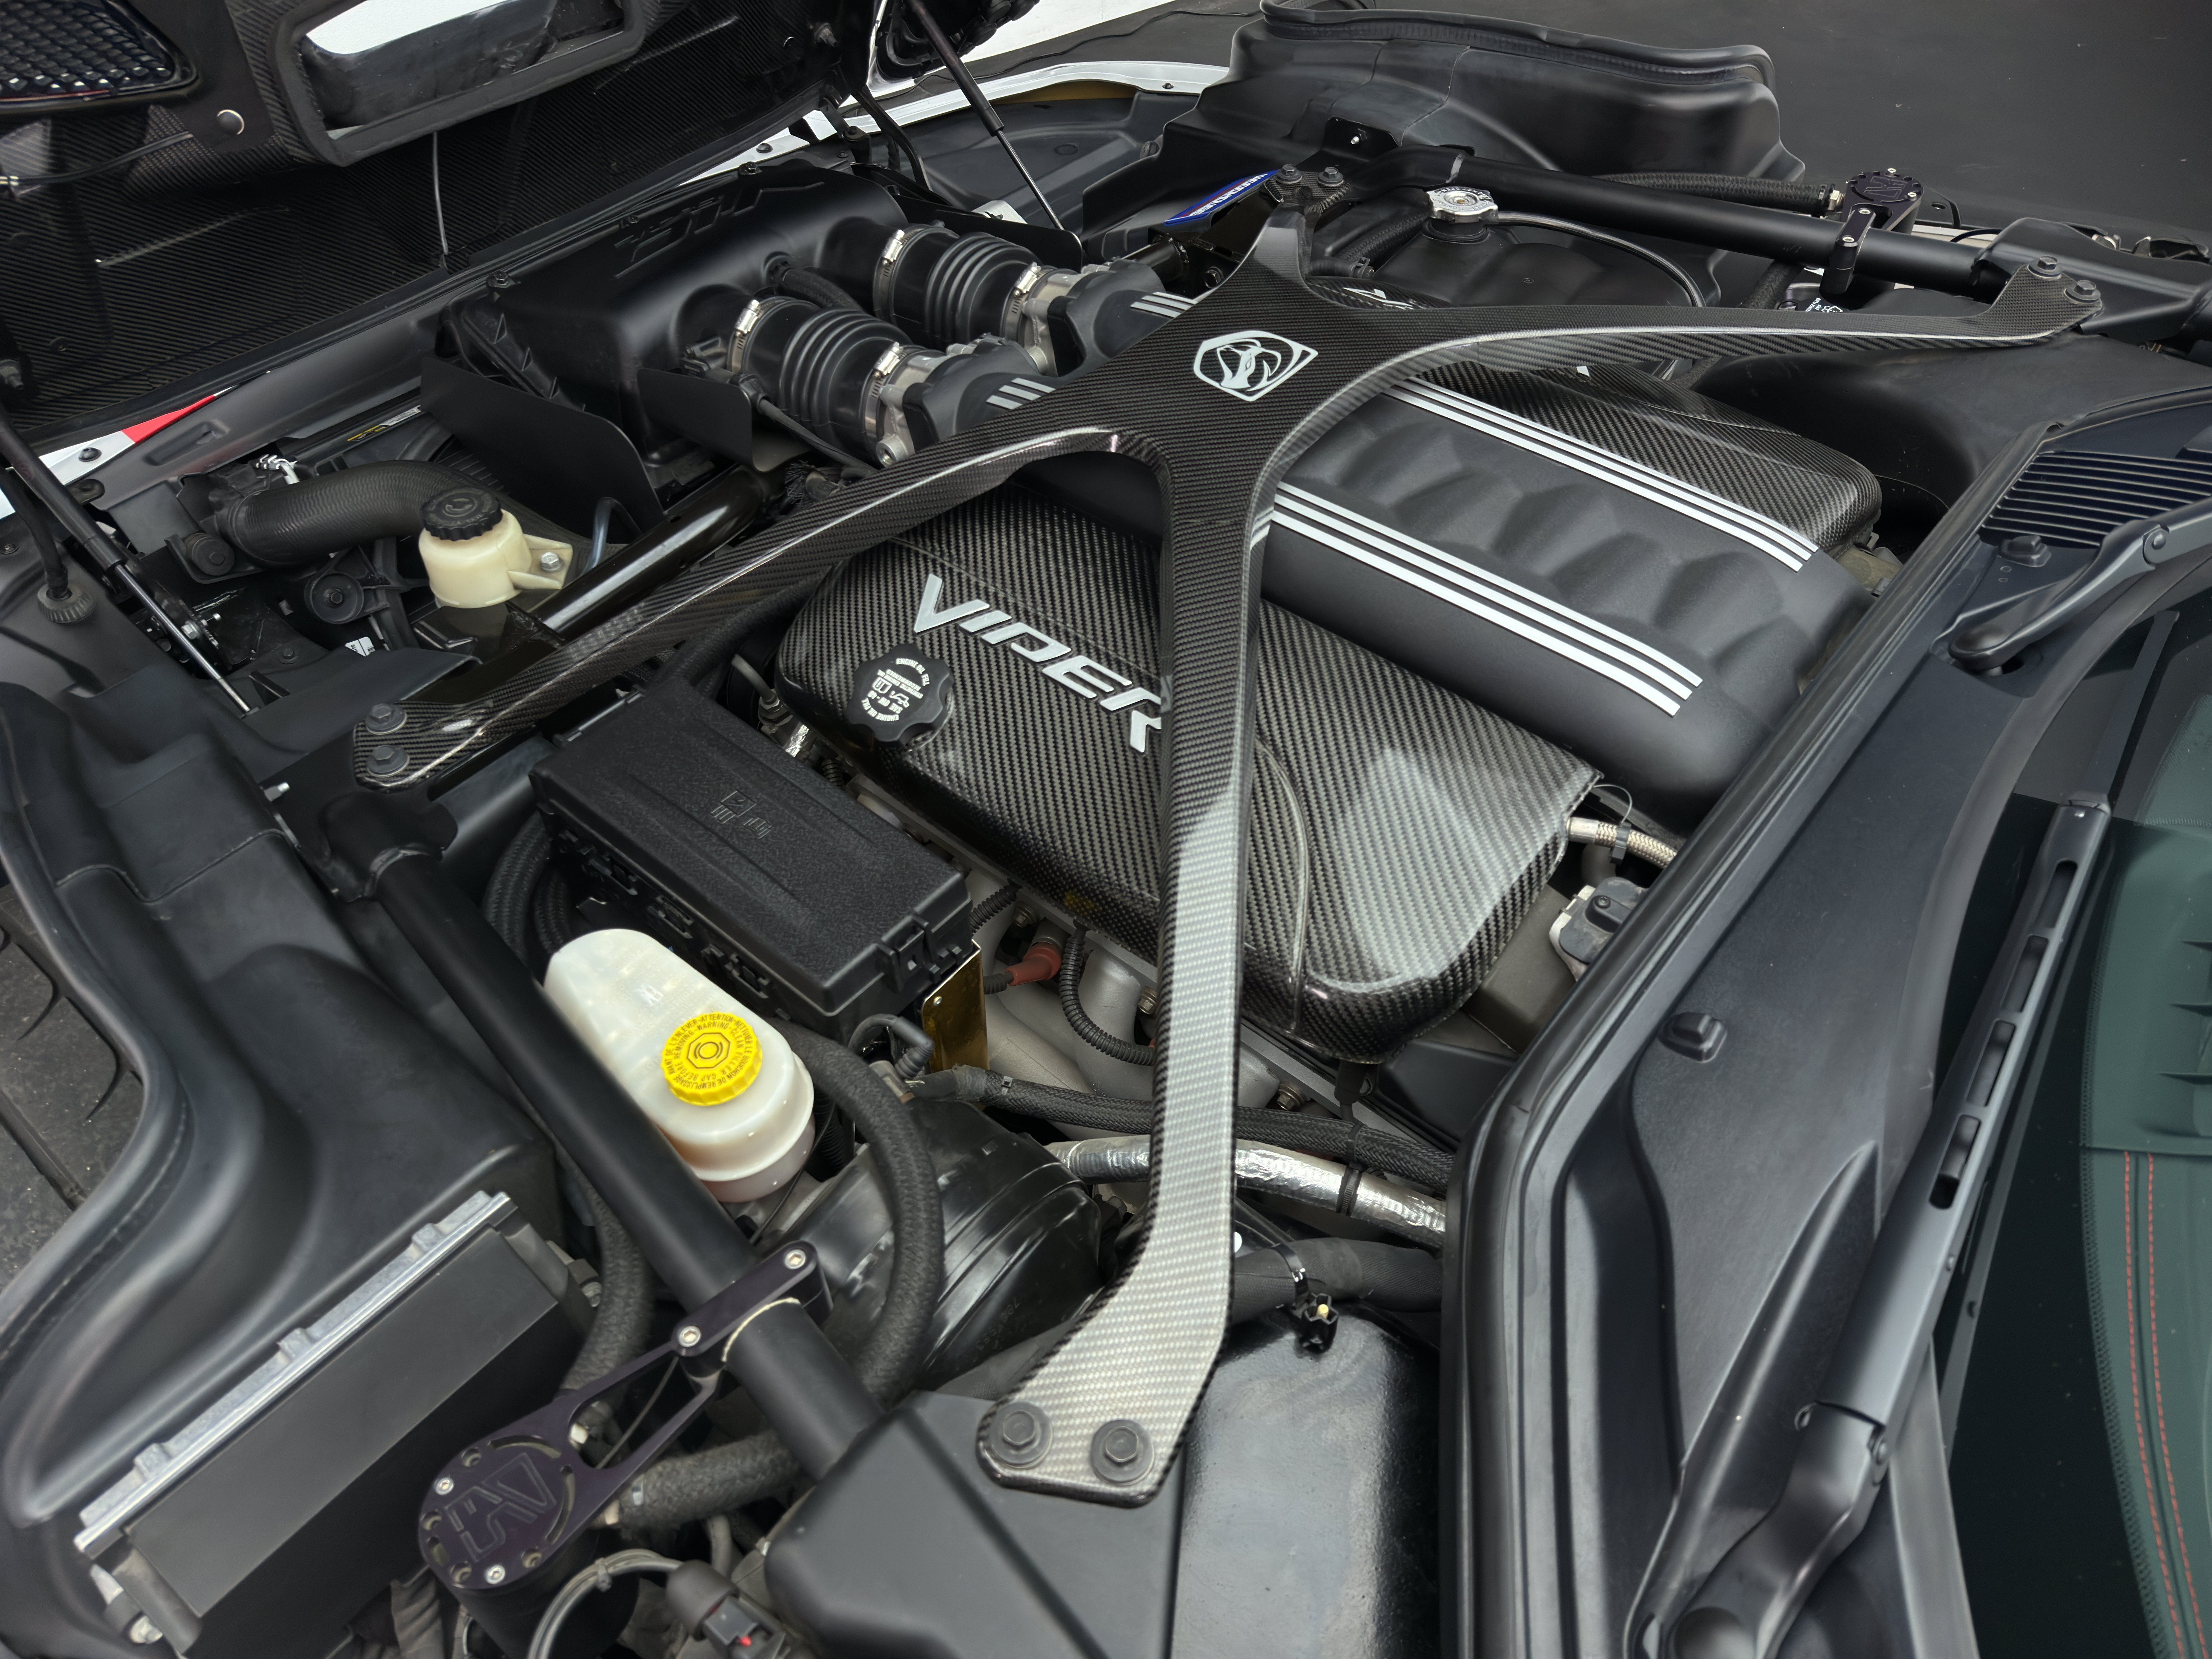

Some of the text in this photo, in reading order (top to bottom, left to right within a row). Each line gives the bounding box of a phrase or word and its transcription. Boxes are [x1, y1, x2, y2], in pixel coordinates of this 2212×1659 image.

[914, 574, 1161, 753] VIPER
[883, 675, 901, 686] ENGINE
[886, 669, 921, 691] RECOMMENDED
[896, 658, 930, 687] ENGINE OIL FILL
[900, 683, 924, 699] SYNTHETIC
[861, 697, 899, 722] ENGINE OIL FILL
[889, 703, 903, 714] SAE
[674, 1031, 694, 1060] REMOVING
[731, 1028, 745, 1049] CLEAN
[665, 1048, 674, 1056] DE
[744, 1046, 753, 1054] LE
[665, 1059, 676, 1075] AVANT
[677, 1062, 700, 1081] BEFORE
[722, 1051, 743, 1076] FILLER
[727, 1055, 750, 1080] BOUCHON
[673, 1075, 717, 1089] REMPLISSAGE
[701, 1074, 717, 1082] CAP
[716, 1076, 727, 1085] DE
